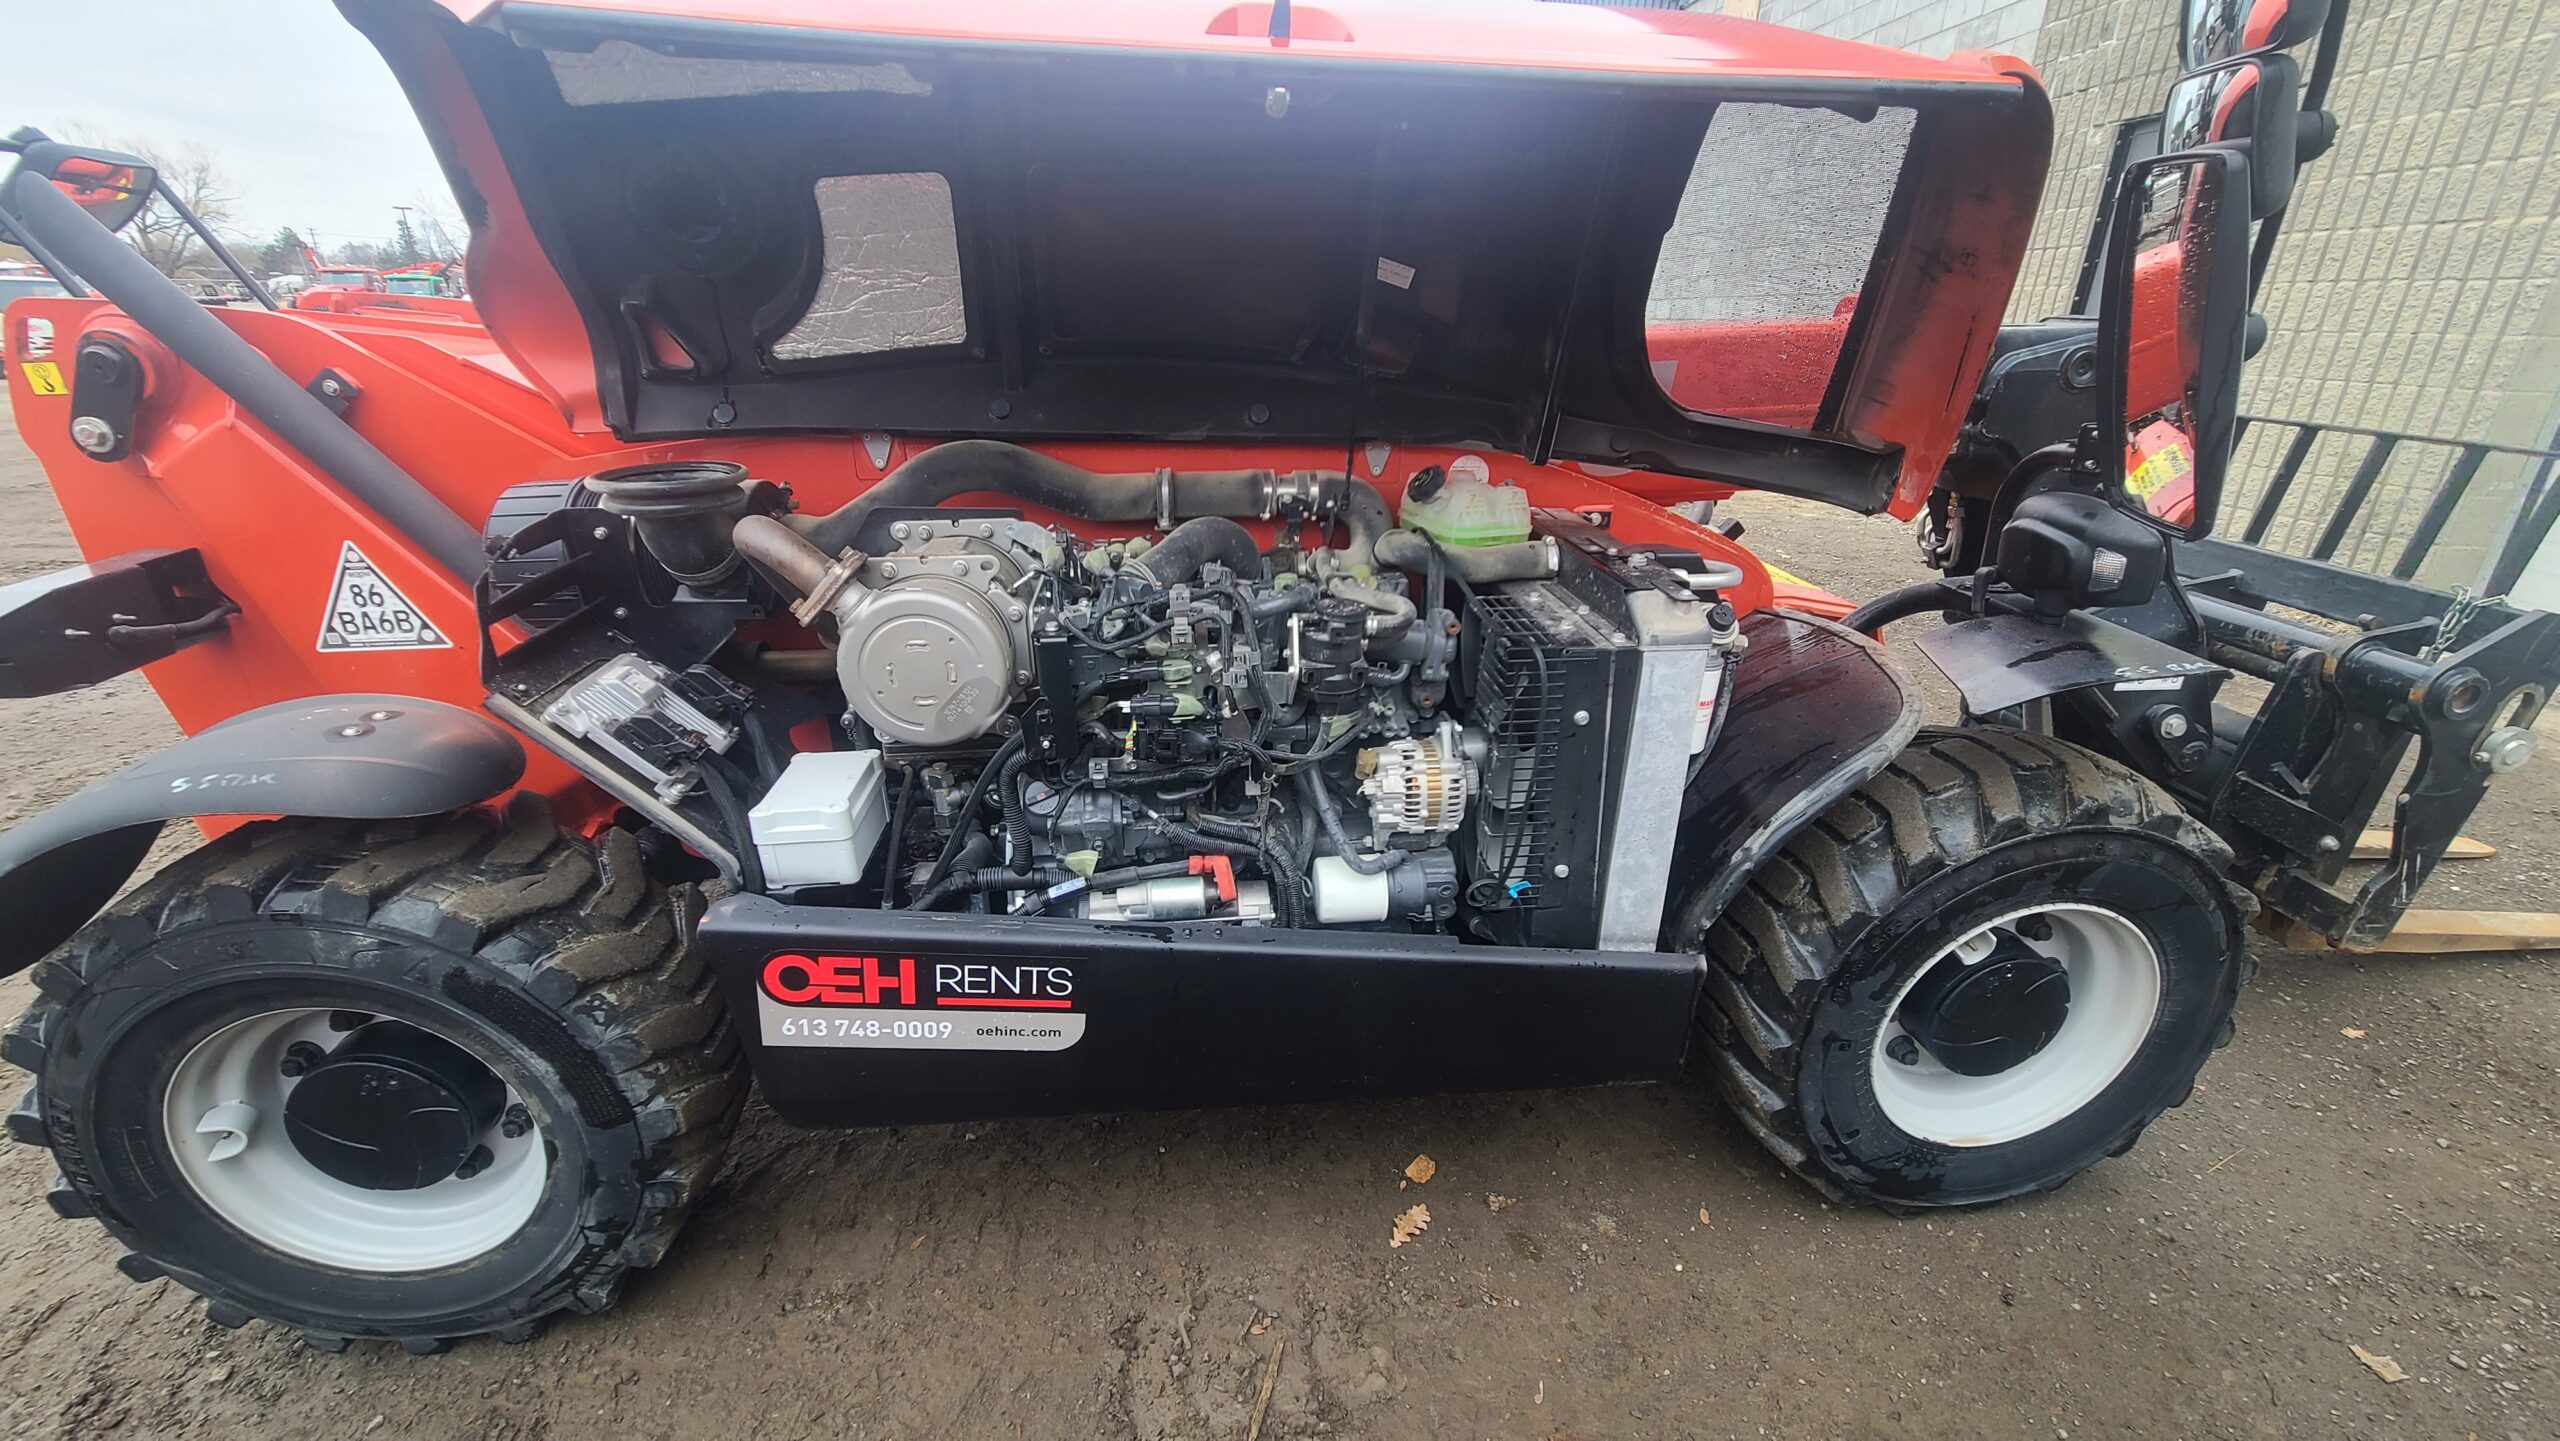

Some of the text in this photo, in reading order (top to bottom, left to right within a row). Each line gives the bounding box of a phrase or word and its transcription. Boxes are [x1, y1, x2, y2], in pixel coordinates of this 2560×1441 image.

[349, 583, 385, 608] 86
[337, 610, 415, 635] BA6B
[763, 954, 1074, 1005] OEH RENTS
[781, 1018, 1062, 1039] 613 748-0009 oehinc.com
